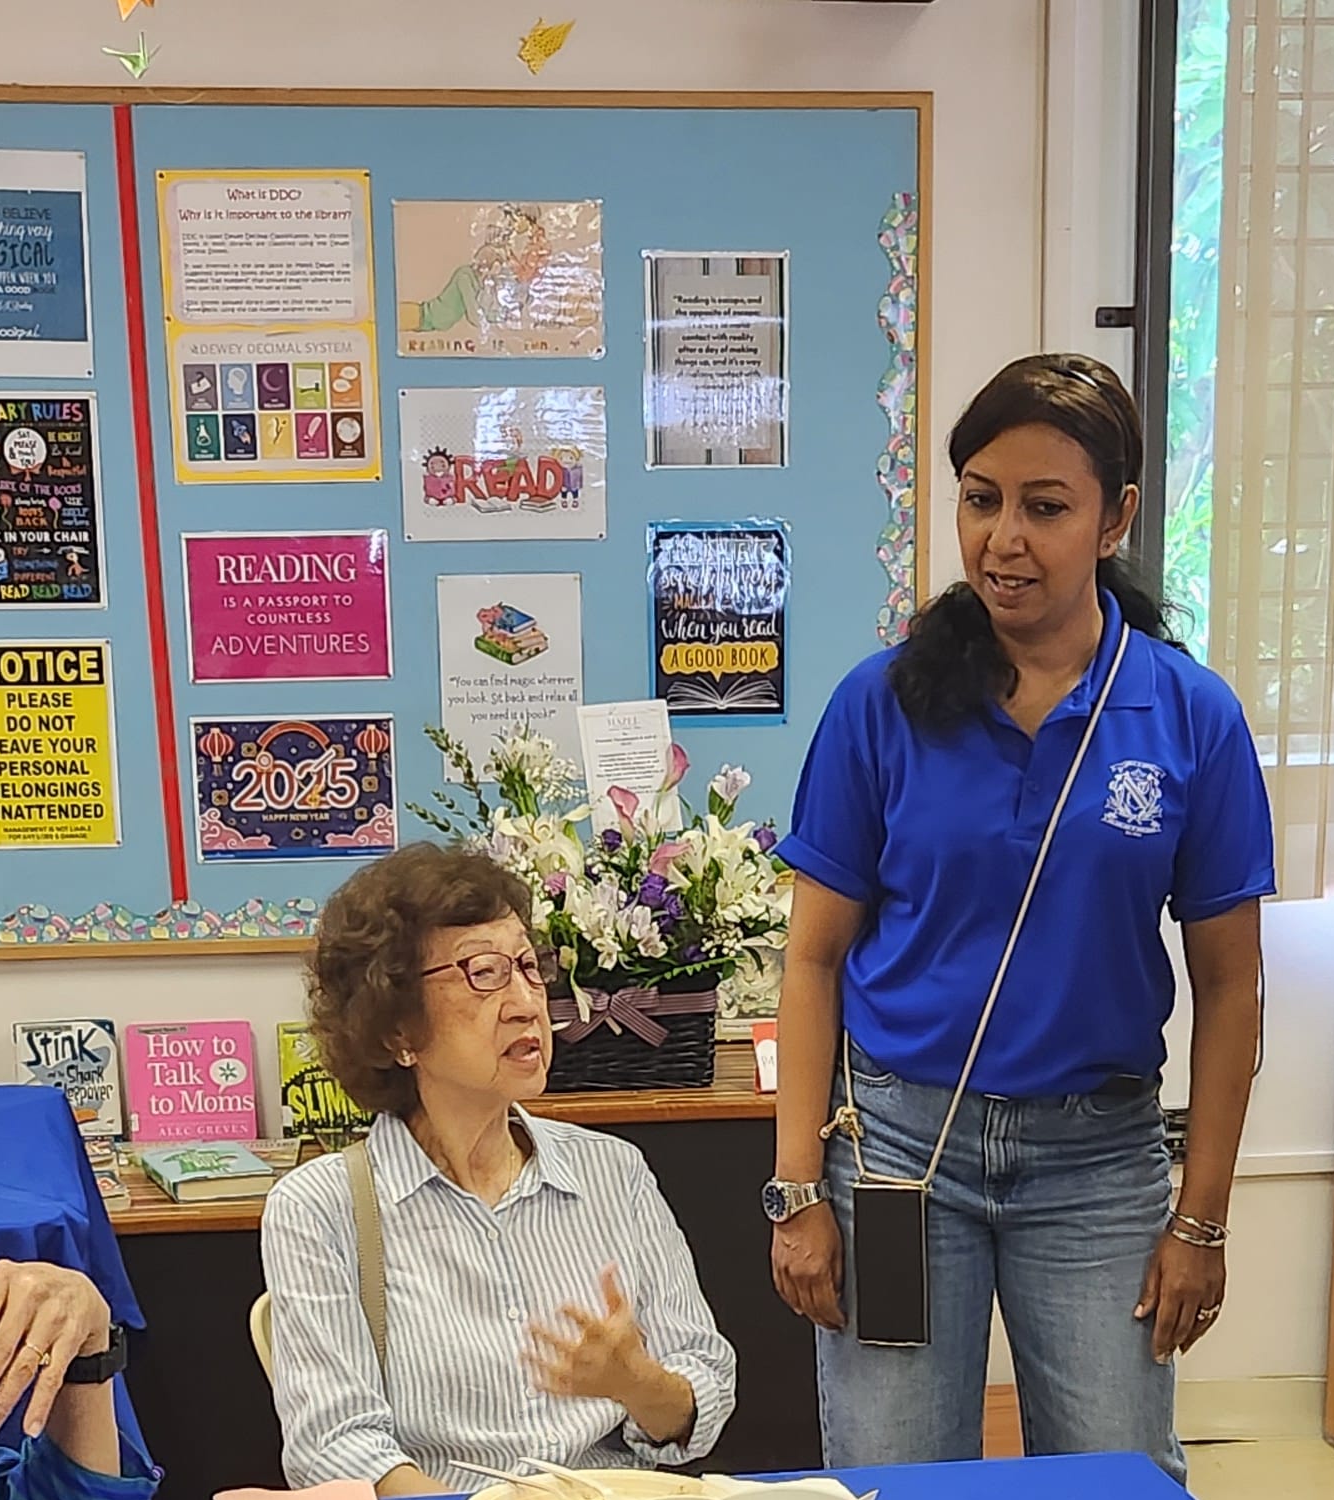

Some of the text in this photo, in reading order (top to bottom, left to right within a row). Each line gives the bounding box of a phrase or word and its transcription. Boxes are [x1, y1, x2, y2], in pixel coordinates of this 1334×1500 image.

[227, 188, 302, 201] What is DDC?
[178, 209, 352, 222] Why is it important to the library?
[200, 342, 353, 355] DEWEY DECIMAL SYSTEM
[32, 403, 83, 422] RULES
[453, 456, 563, 503] READ
[4, 531, 17, 542] IN
[20, 531, 50, 542] YOUR
[54, 531, 90, 542] CHAIR
[217, 553, 357, 584] READING
[0, 585, 30, 599] READ
[63, 585, 92, 599] READ
[223, 595, 353, 608] IS A PASSPORT TO
[247, 612, 331, 624] COUNTLESS
[661, 612, 779, 644] When you read
[211, 634, 370, 656] ADVENTURES
[670, 647, 769, 667] A GOOD BOOK
[473, 679, 488, 687] can
[490, 674, 508, 687] find
[510, 678, 536, 688] magic
[6, 692, 72, 708] PLEASE
[448, 696, 465, 707] you
[506, 692, 525, 702] back
[529, 691, 543, 701] and
[6, 715, 75, 732] DO NOT
[471, 713, 487, 723] you
[490, 709, 508, 720] need
[48, 738, 97, 753] YOUR
[231, 757, 359, 811] 2025
[262, 811, 330, 823] HAPPY NEW YEAR
[22, 1026, 102, 1068] Stink
[146, 1034, 236, 1058] How to
[67, 1064, 104, 1085] Shark
[147, 1062, 204, 1087] Talk
[151, 1090, 255, 1115] to Moms
[159, 1123, 248, 1137] ALEC GREVEN
